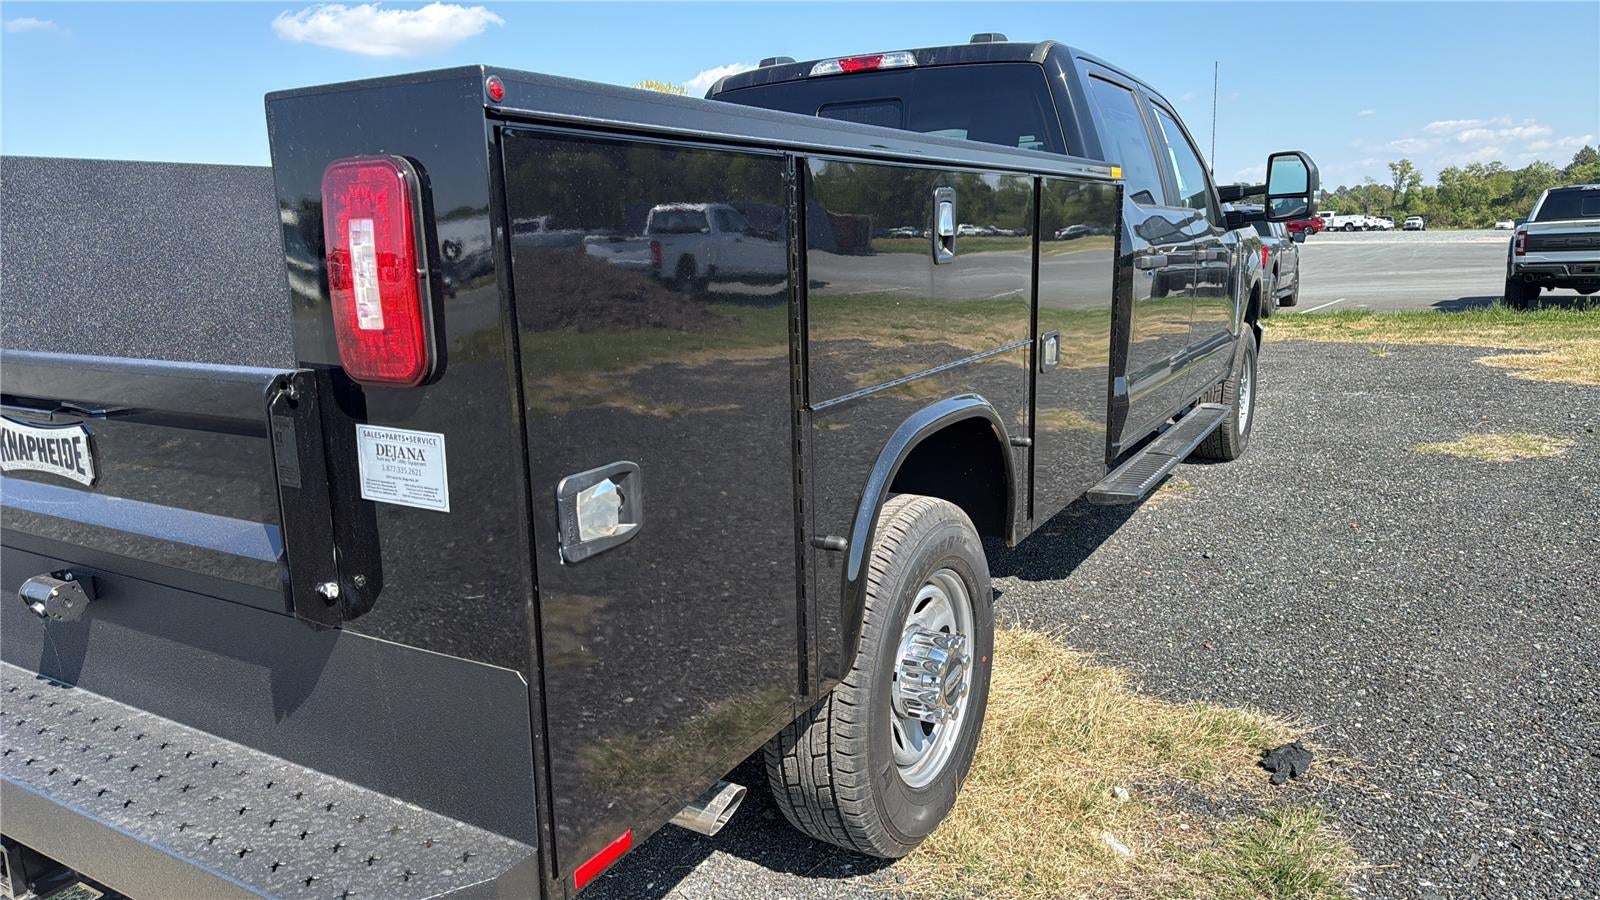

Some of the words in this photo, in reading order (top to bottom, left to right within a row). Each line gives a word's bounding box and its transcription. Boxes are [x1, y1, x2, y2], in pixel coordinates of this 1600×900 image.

[363, 430, 381, 439] SALES
[385, 433, 405, 442] PARTS
[409, 436, 437, 446] SERVICE
[0, 427, 86, 476] KNAPHEIDE
[376, 443, 425, 461] DEJANA
